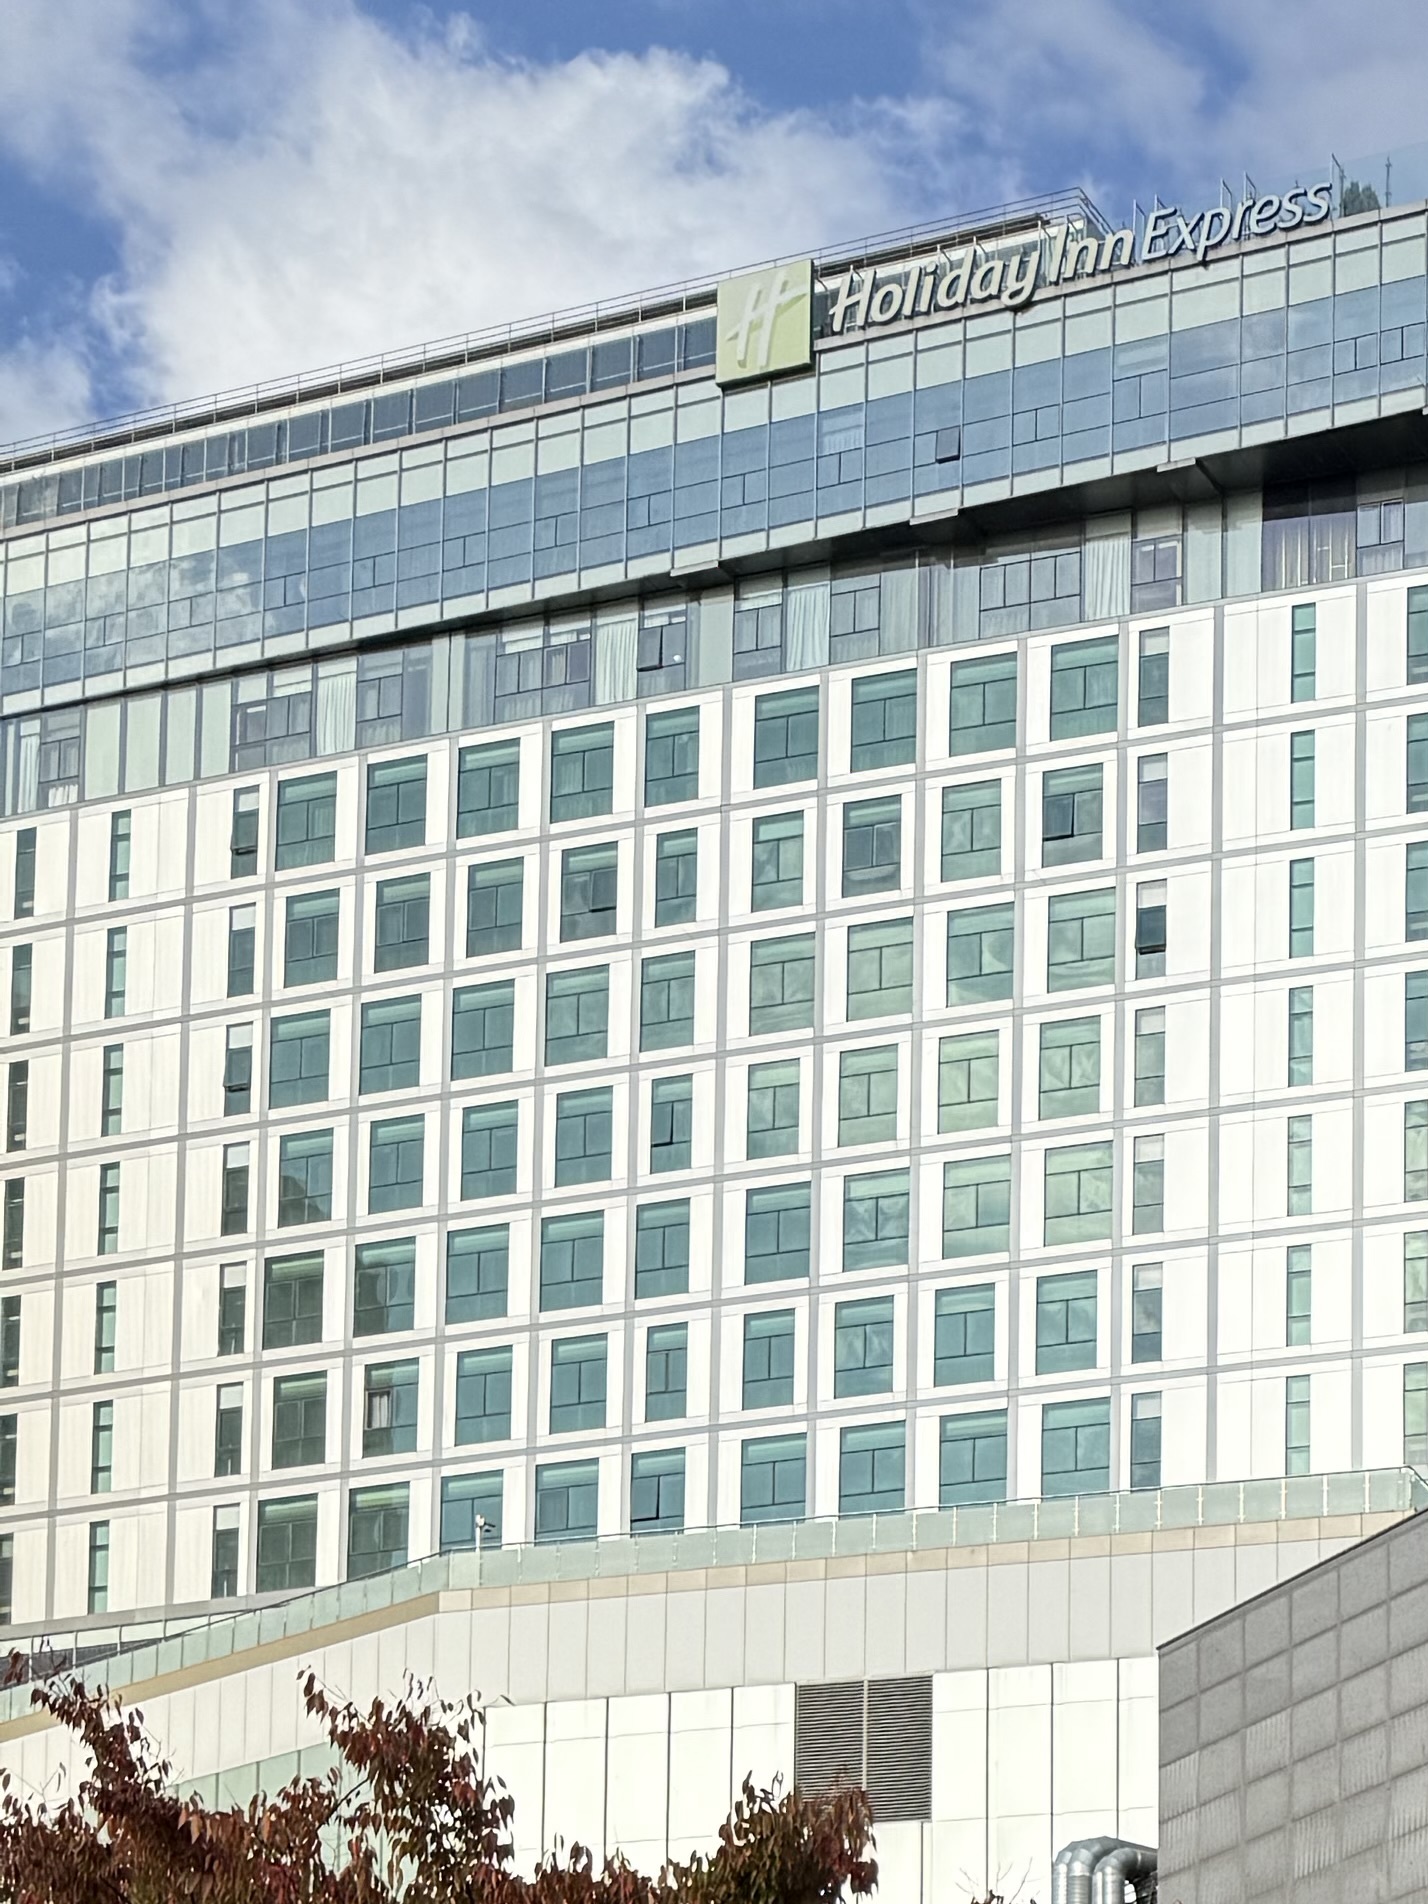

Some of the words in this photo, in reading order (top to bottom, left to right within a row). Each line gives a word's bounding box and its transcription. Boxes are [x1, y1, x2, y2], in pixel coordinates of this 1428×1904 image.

[828, 249, 1038, 334] Holiday
[1050, 226, 1136, 284] Inn
[1140, 182, 1333, 267] Express
